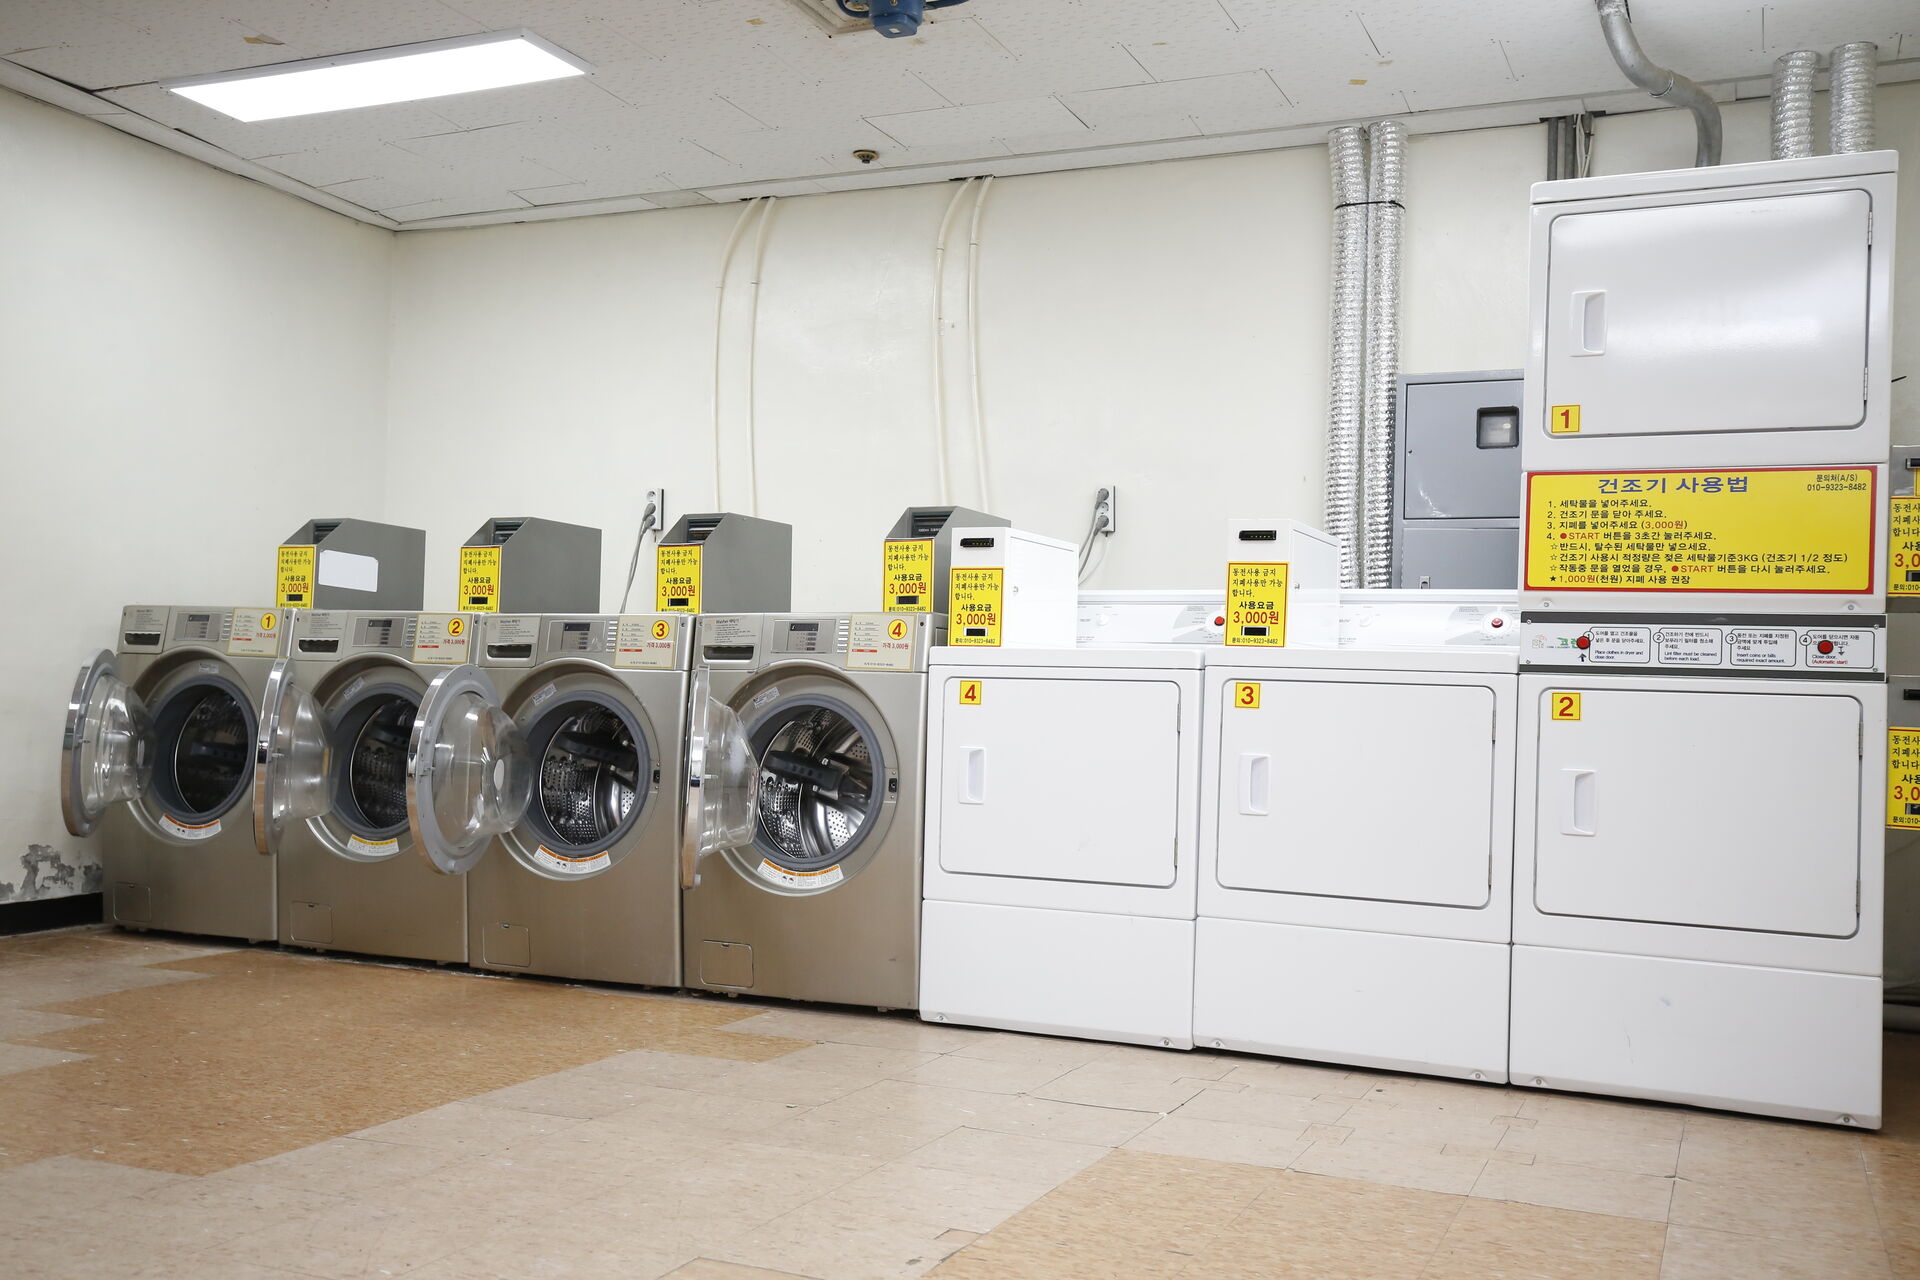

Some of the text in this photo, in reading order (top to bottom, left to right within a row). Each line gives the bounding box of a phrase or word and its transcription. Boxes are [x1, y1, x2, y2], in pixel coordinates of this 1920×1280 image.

[1560, 409, 1570, 428] 1
[1816, 474, 1858, 482] 문의처(A/S)
[1598, 476, 1748, 494] 건조기 사용법
[1807, 483, 1867, 491] 010-9323-8482
[1560, 500, 1597, 508] 세탁물을
[1601, 500, 1652, 508] 넣어주세요.
[1547, 511, 1556, 519] 2.
[1560, 511, 1587, 519] 건조기
[1591, 511, 1609, 519] 문을
[1635, 510, 1667, 519] 주세요.
[1559, 521, 1587, 530] 지폐를
[1591, 521, 1638, 530] 넣어주세요
[1641, 520, 1688, 530] (3,000원)
[1603, 532, 1631, 540] 버튼을
[1635, 532, 1660, 540] 3초간
[1664, 532, 1716, 540] 눌러주세요.
[1594, 542, 1623, 551] 탈수된
[1626, 542, 1665, 551] 세탁물만
[1668, 542, 1711, 551] 넣으세요.
[1559, 553, 1848, 563] 건조기 사용시 적정량은 젖은 세탁물기준3KG (건조기 1/2 정도)
[1233, 568, 1260, 576] 동전사용
[1559, 564, 1587, 572] 작동중
[1590, 564, 1609, 572] 문을
[1612, 564, 1640, 573] 열었을
[1717, 565, 1747, 574] 버튼을
[1751, 565, 1770, 574] 다시
[1774, 565, 1830, 574] 눌러주세요.
[1232, 579, 1283, 587] 지폐사용만 가능
[1626, 575, 1644, 584] 지폐
[1648, 575, 1667, 584] 사용
[1671, 575, 1690, 584] 권장
[281, 582, 309, 593] 3,000원
[464, 584, 494, 595] 3,000원
[661, 585, 695, 597] 3,000원
[889, 582, 927, 594] 3,000원
[1232, 589, 1255, 598] 합니다.
[961, 604, 992, 612] 사용요금
[1239, 601, 1274, 610] 사용요금
[266, 616, 271, 628] 1
[956, 613, 996, 626] 3,000원
[1233, 611, 1279, 625] 3,000원
[452, 621, 460, 633] 2
[656, 623, 665, 637] 3
[892, 622, 902, 637] 4
[964, 684, 976, 701] 4
[1241, 686, 1254, 704] 3
[1559, 696, 1574, 716] 2
